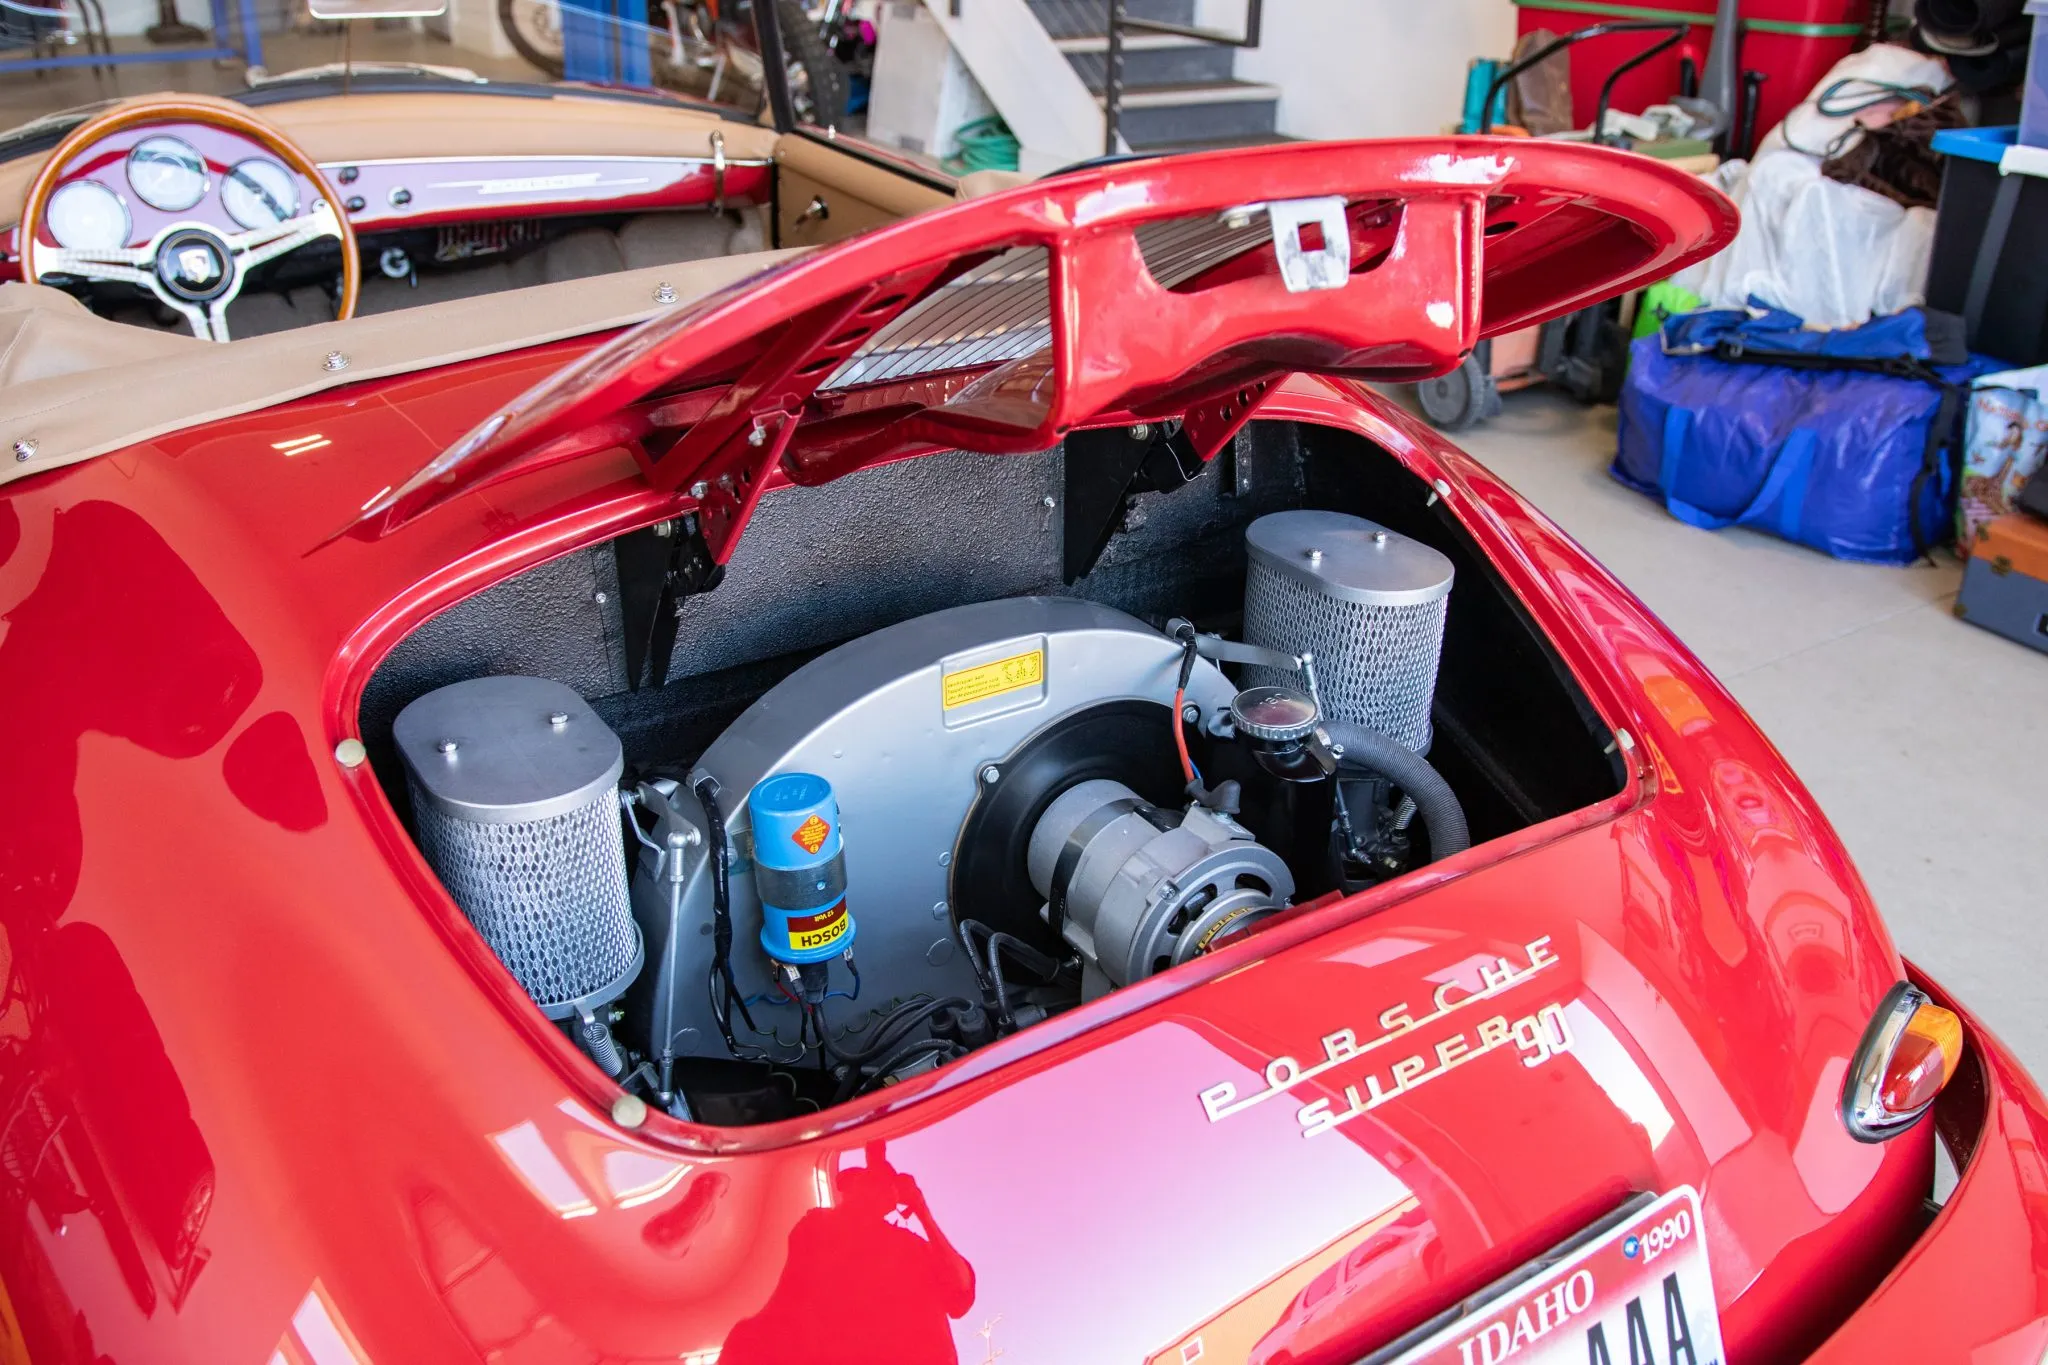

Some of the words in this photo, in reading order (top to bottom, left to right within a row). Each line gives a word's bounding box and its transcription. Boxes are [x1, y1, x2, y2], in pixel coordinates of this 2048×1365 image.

[801, 919, 846, 947] BOSCH
[814, 912, 827, 922] Volt
[1198, 936, 1559, 1122] PORSCHE
[1297, 1015, 1512, 1138] SUPER
[1512, 1003, 1575, 1068] 90
[1639, 1210, 1691, 1264] 1990
[1458, 1269, 1595, 1365] IDAHO
